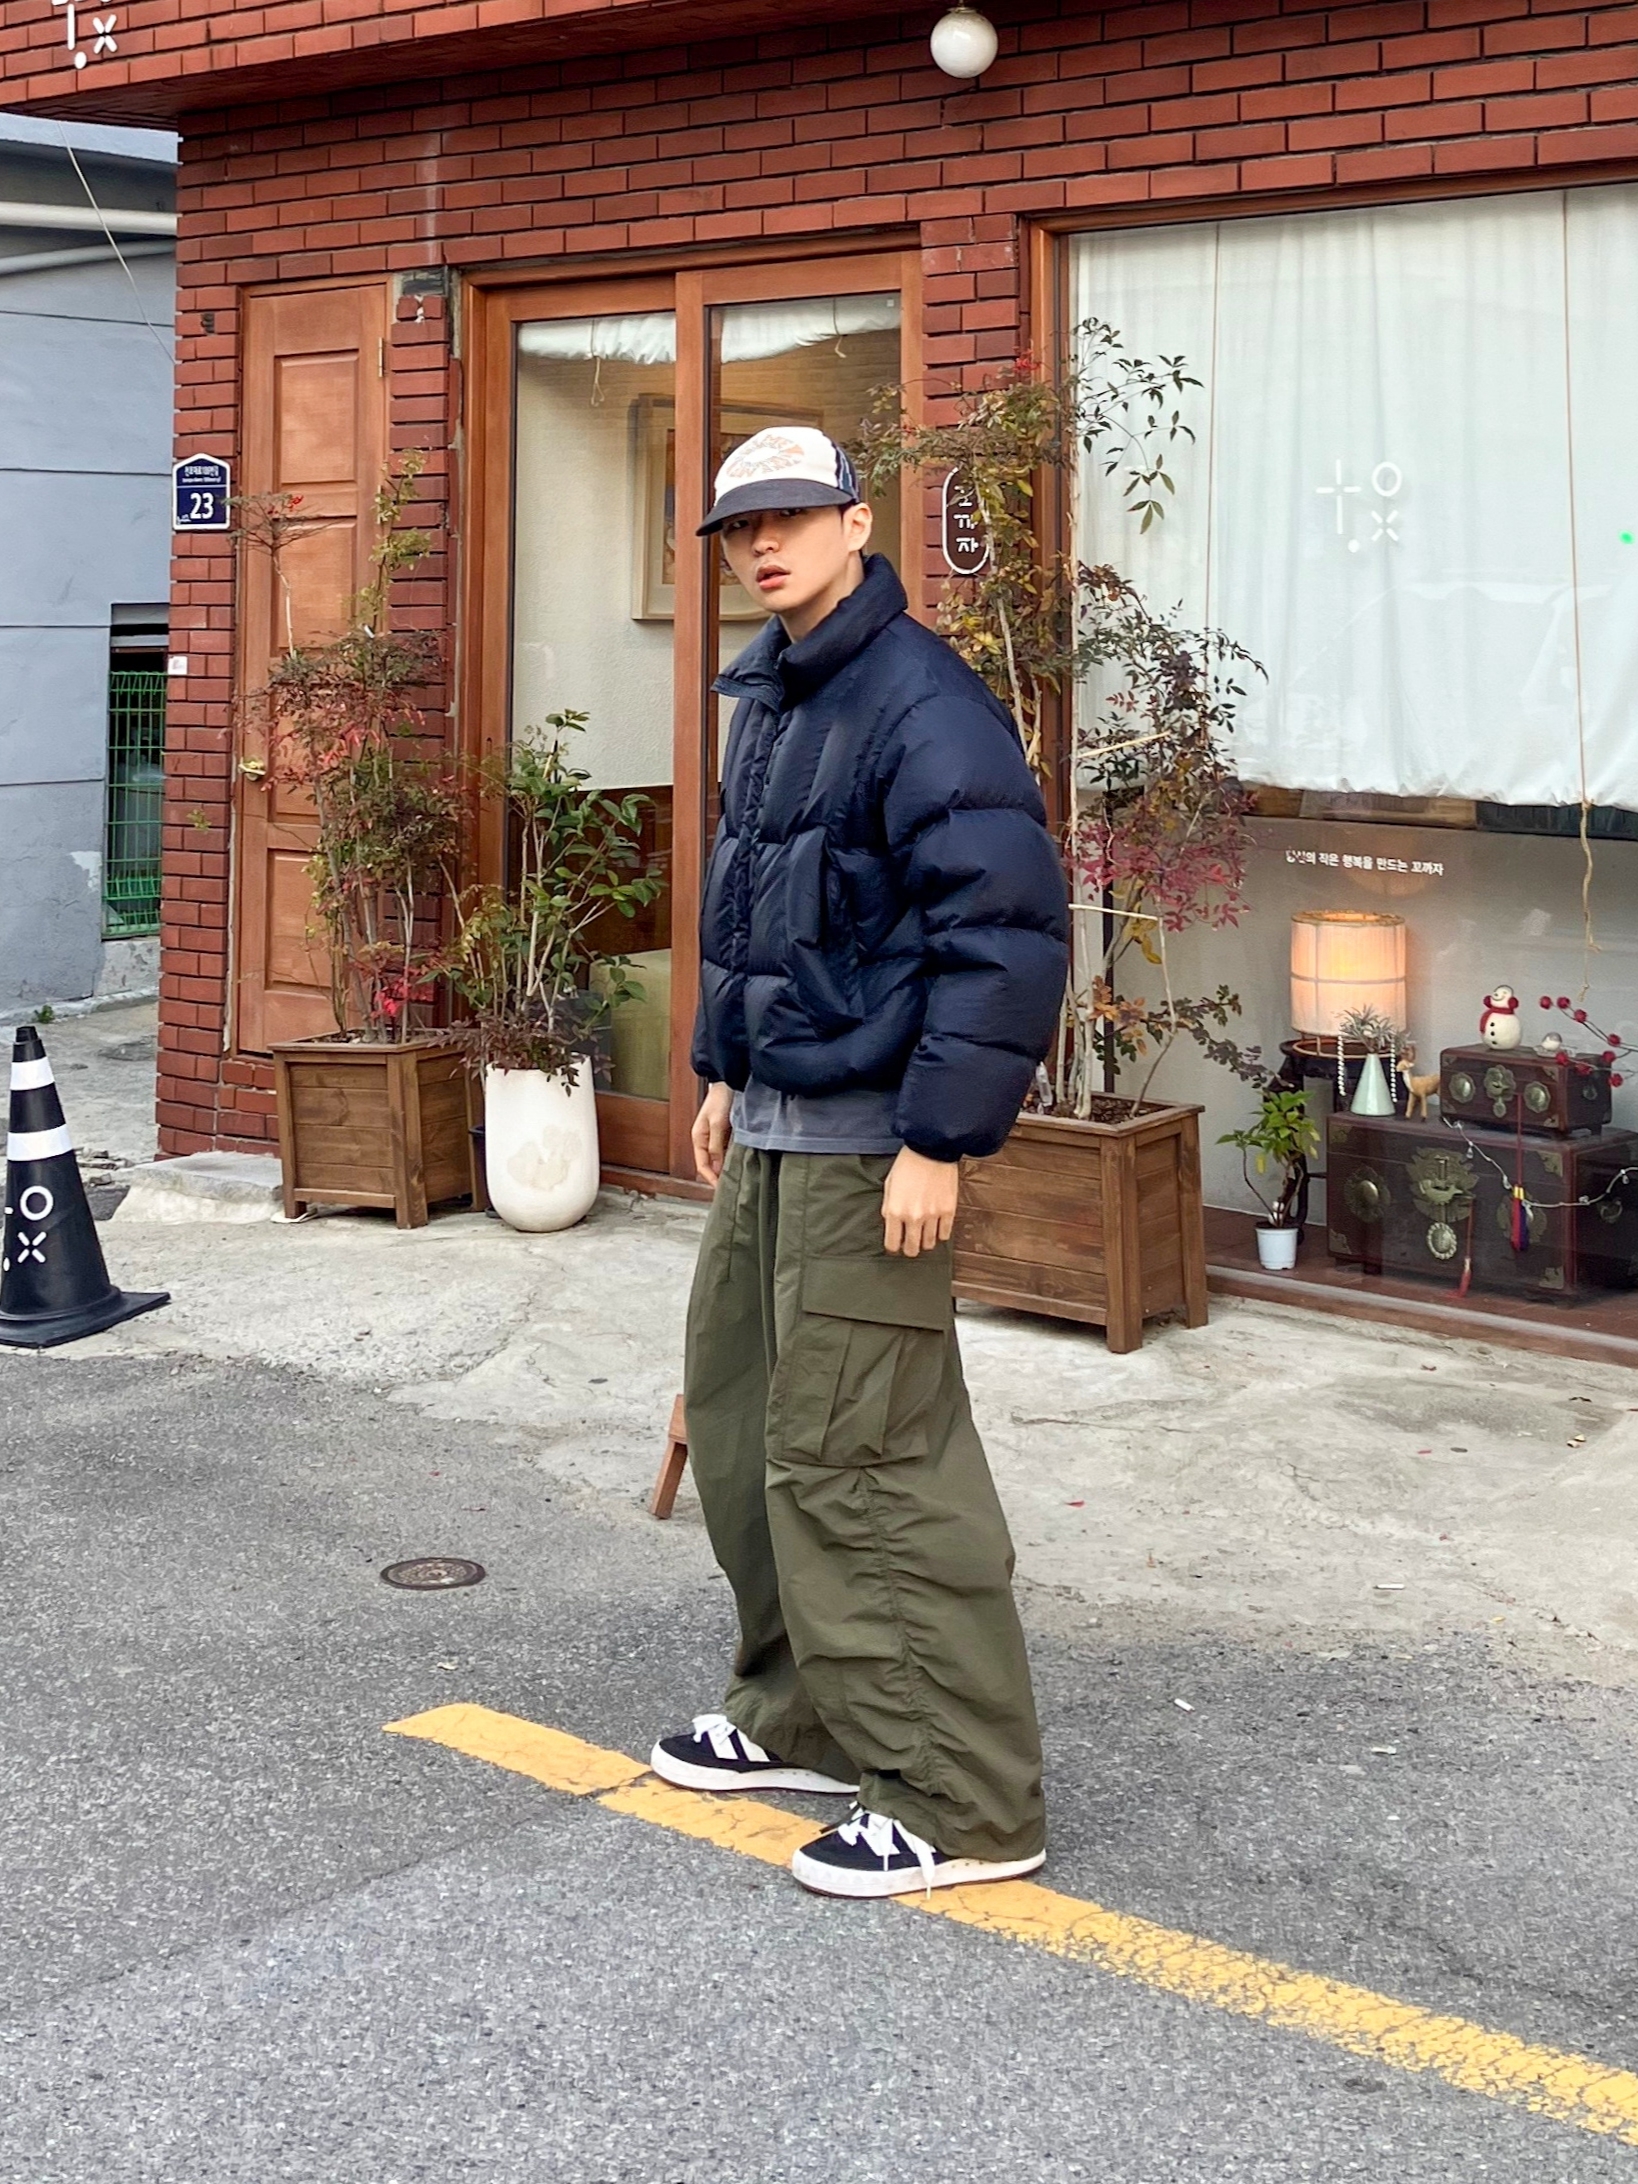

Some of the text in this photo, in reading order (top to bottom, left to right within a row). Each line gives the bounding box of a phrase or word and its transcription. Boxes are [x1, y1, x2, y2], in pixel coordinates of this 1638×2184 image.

[190, 492, 214, 520] 23
[1318, 852, 1340, 867] 작은
[1342, 854, 1374, 871] 행복을
[1376, 857, 1409, 873] 만드는
[1410, 860, 1445, 877] 꼬까자
